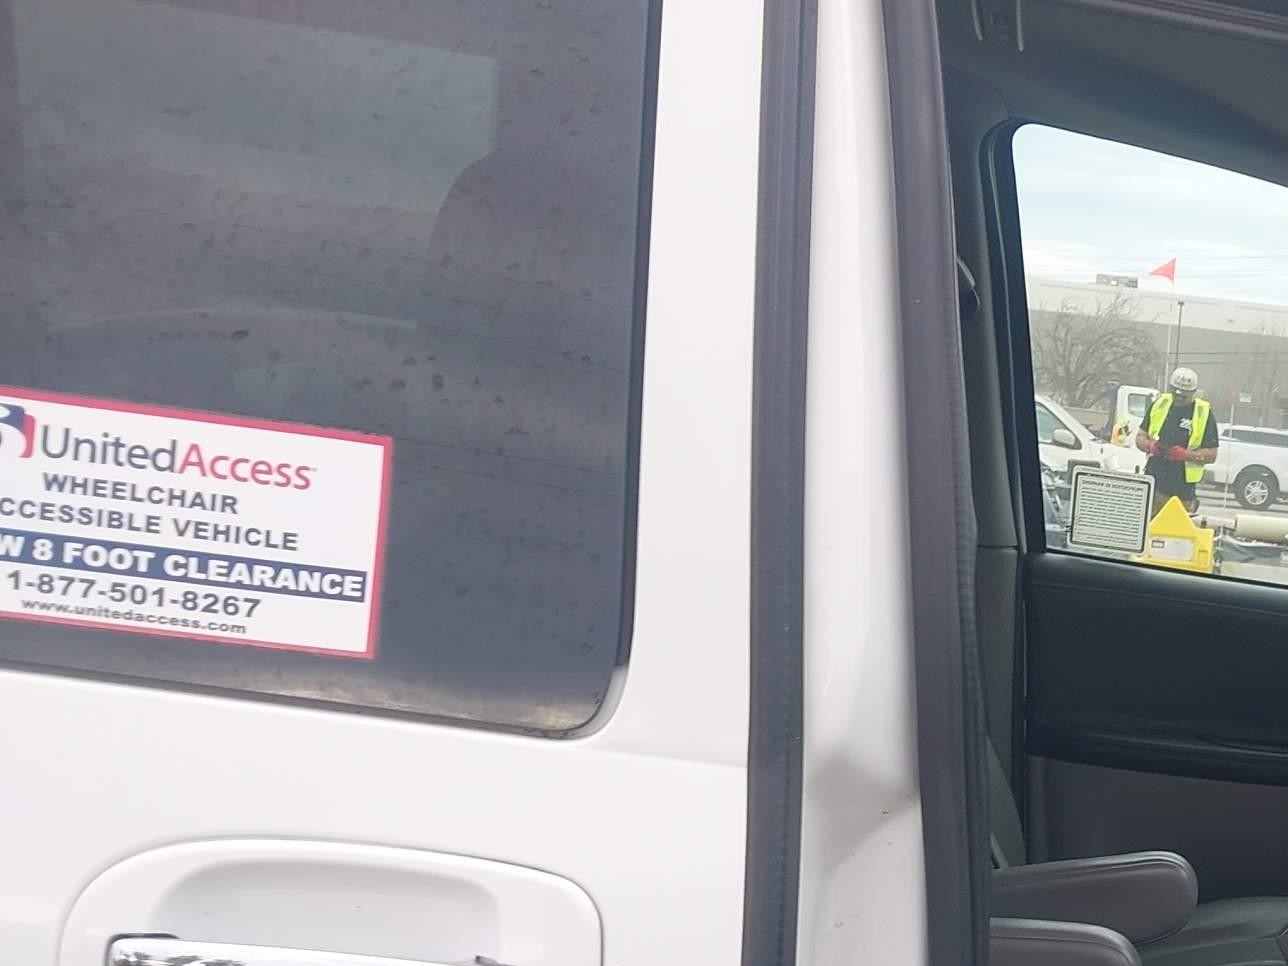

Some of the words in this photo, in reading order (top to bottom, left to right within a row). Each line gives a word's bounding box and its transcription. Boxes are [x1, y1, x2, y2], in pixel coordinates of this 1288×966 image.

[41, 424, 312, 490] UnitedAccess
[42, 472, 238, 514] WHEELCHAIR
[0, 497, 161, 534] CCESSIBLE
[173, 517, 298, 551] VEHICLE
[32, 538, 54, 561] 8
[62, 541, 156, 573] FOOT
[163, 554, 364, 597] CLEARANCE
[7, 569, 261, 618] 1-877-501-8267
[21, 600, 247, 634] www.unitedaccess.com
